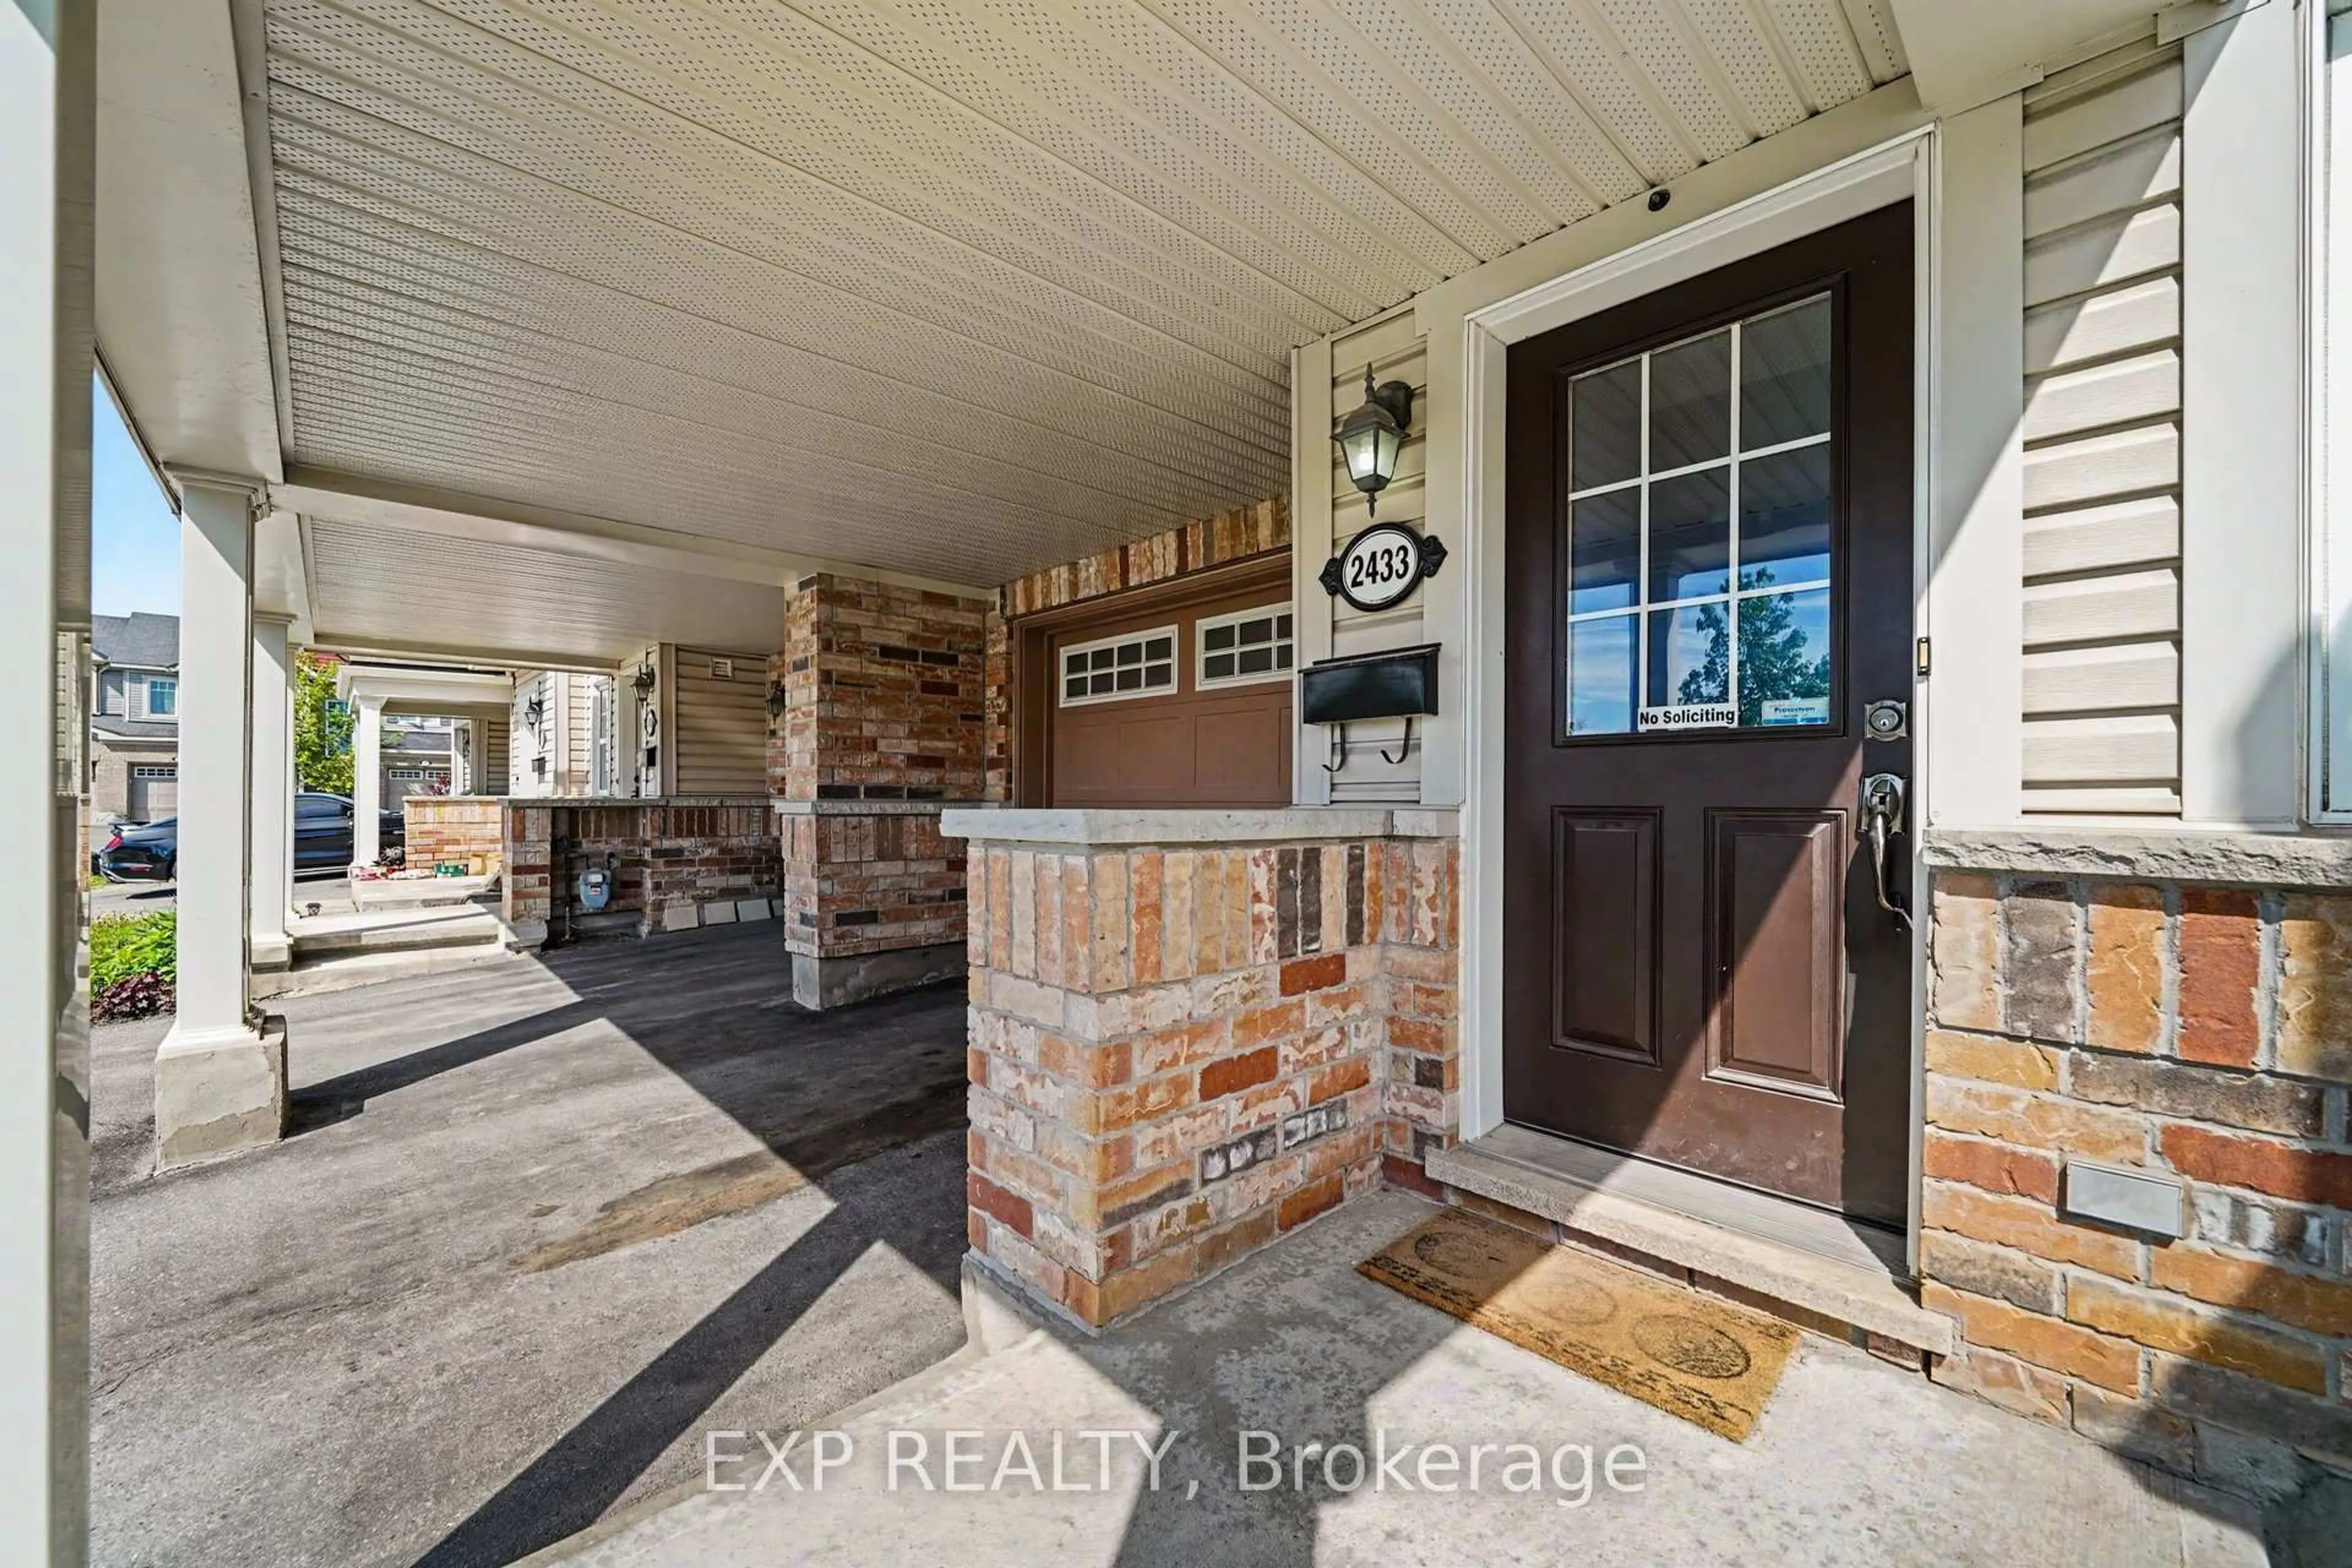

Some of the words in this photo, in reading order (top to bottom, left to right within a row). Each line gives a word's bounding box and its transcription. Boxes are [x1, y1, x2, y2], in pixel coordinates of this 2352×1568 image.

[1351, 545, 1409, 588] 2433
[1640, 712, 1658, 725] No
[1663, 708, 1735, 725] Soliciting
